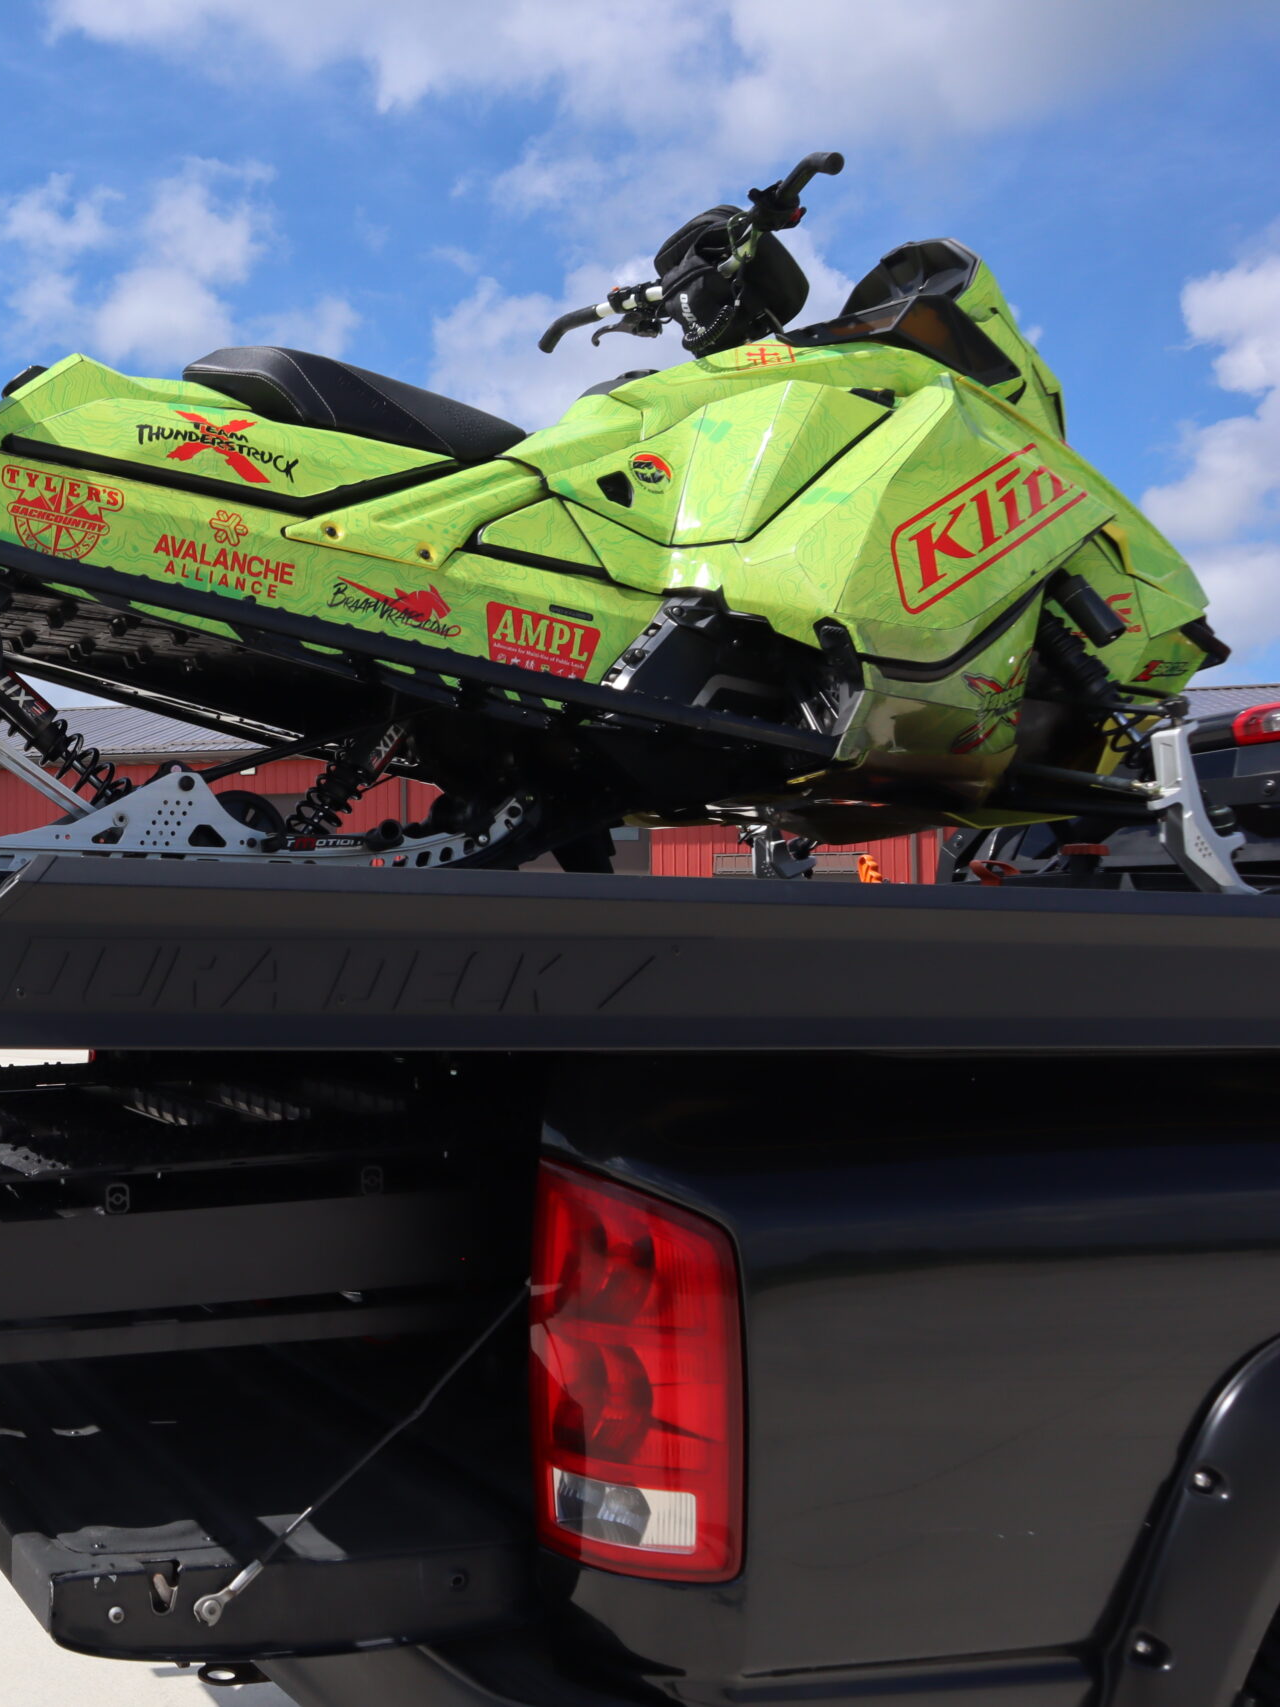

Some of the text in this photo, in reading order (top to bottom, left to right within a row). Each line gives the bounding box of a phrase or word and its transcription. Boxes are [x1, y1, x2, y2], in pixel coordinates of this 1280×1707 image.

[193, 421, 249, 443] TEAM
[135, 423, 299, 484] THUNDERSTRUCK
[6, 468, 119, 507] TYLER'S
[9, 504, 107, 534] BACKCOUNTRY
[17, 518, 96, 560] AWARNESS
[153, 533, 296, 586] AVALANCHE
[163, 559, 279, 599] ALLIANCE
[492, 609, 589, 662] AMPL
